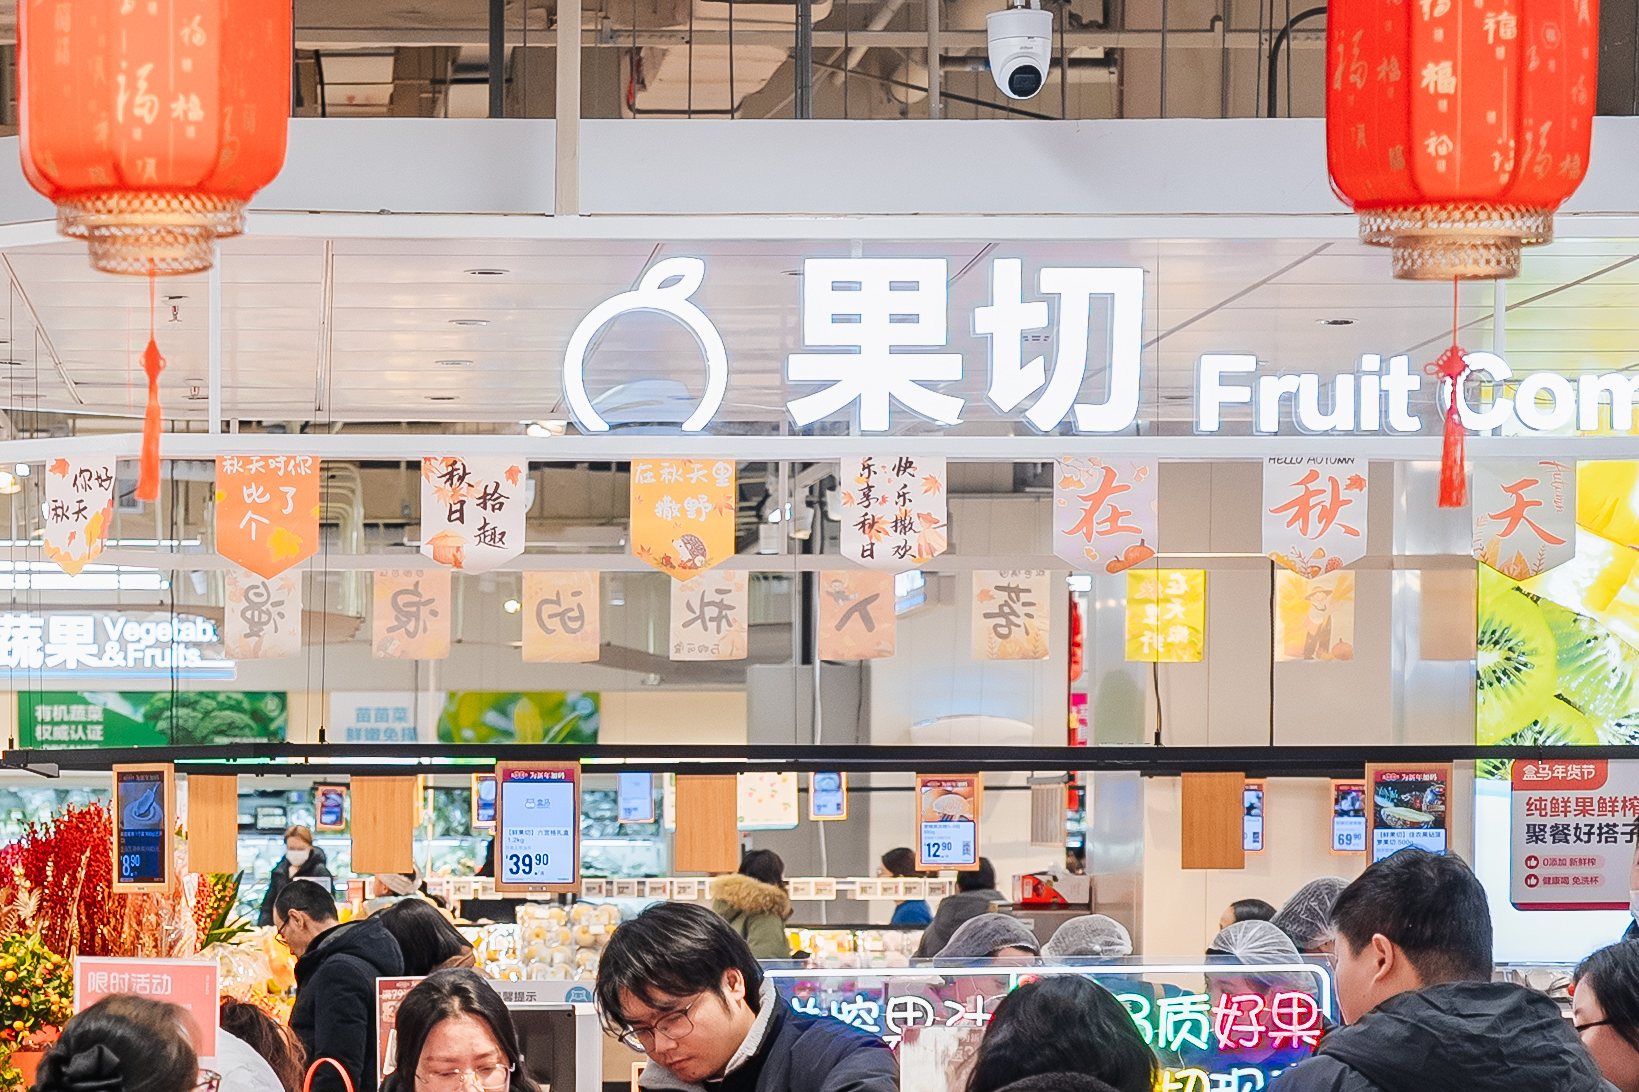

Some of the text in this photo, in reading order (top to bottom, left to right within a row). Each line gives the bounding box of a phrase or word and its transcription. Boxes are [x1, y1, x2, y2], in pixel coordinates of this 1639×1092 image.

[786, 257, 1145, 433] 果切
[1199, 353, 1422, 432] Fruit
[72, 466, 114, 493] 你好
[634, 461, 734, 488] 在秋天里
[50, 499, 89, 524] 秋天
[653, 494, 713, 522] 撒野
[1061, 465, 1144, 544] 在
[1268, 468, 1361, 541] 秋
[1487, 477, 1568, 546] 天
[34, 703, 104, 722] 有机蔬菜
[34, 723, 104, 742] 权威认证
[1523, 764, 1596, 780] 盒马年货节
[1525, 796, 1639, 818] 纯鲜果鲜榨
[1525, 822, 1638, 844] 聚餐好搭子
[87, 971, 173, 995] 限时活动
[498, 990, 538, 1002] 馨提示
